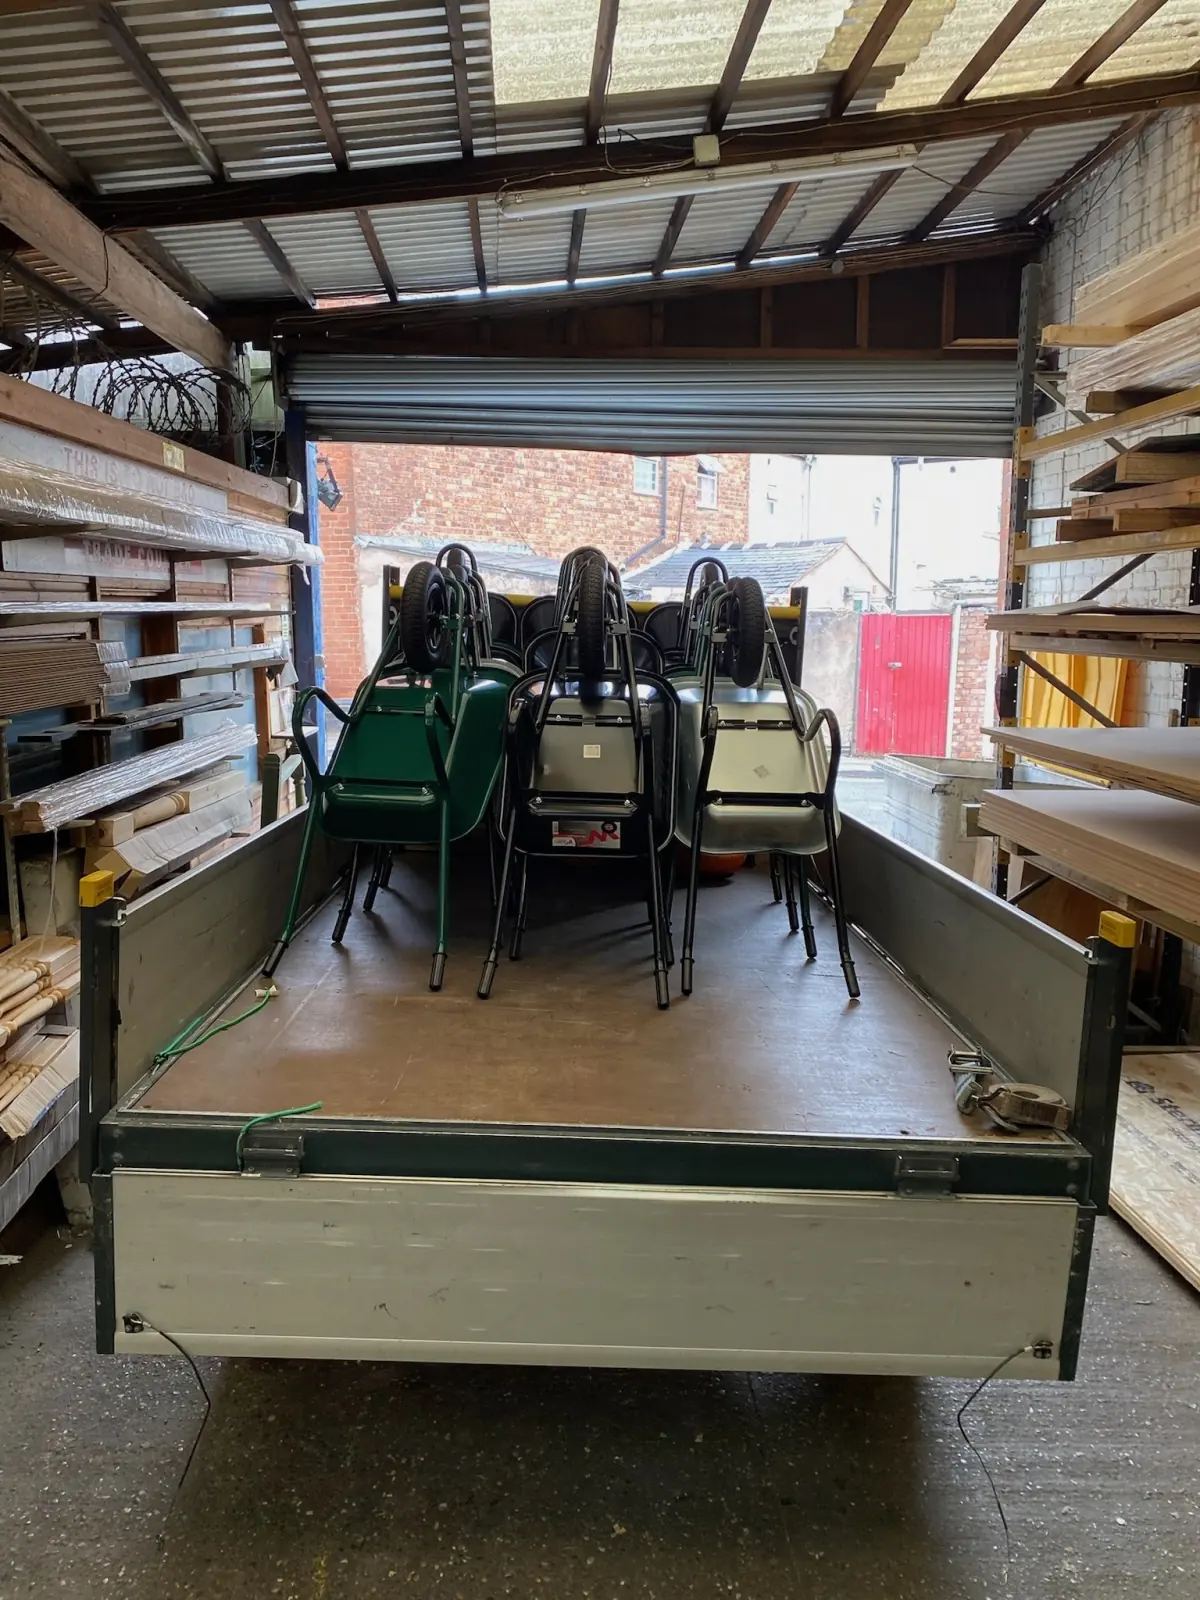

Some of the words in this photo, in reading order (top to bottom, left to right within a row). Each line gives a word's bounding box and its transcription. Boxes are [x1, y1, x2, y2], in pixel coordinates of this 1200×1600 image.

[63, 446, 99, 481] THIS
[104, 458, 119, 483] IS
[83, 540, 132, 565] TRADE
